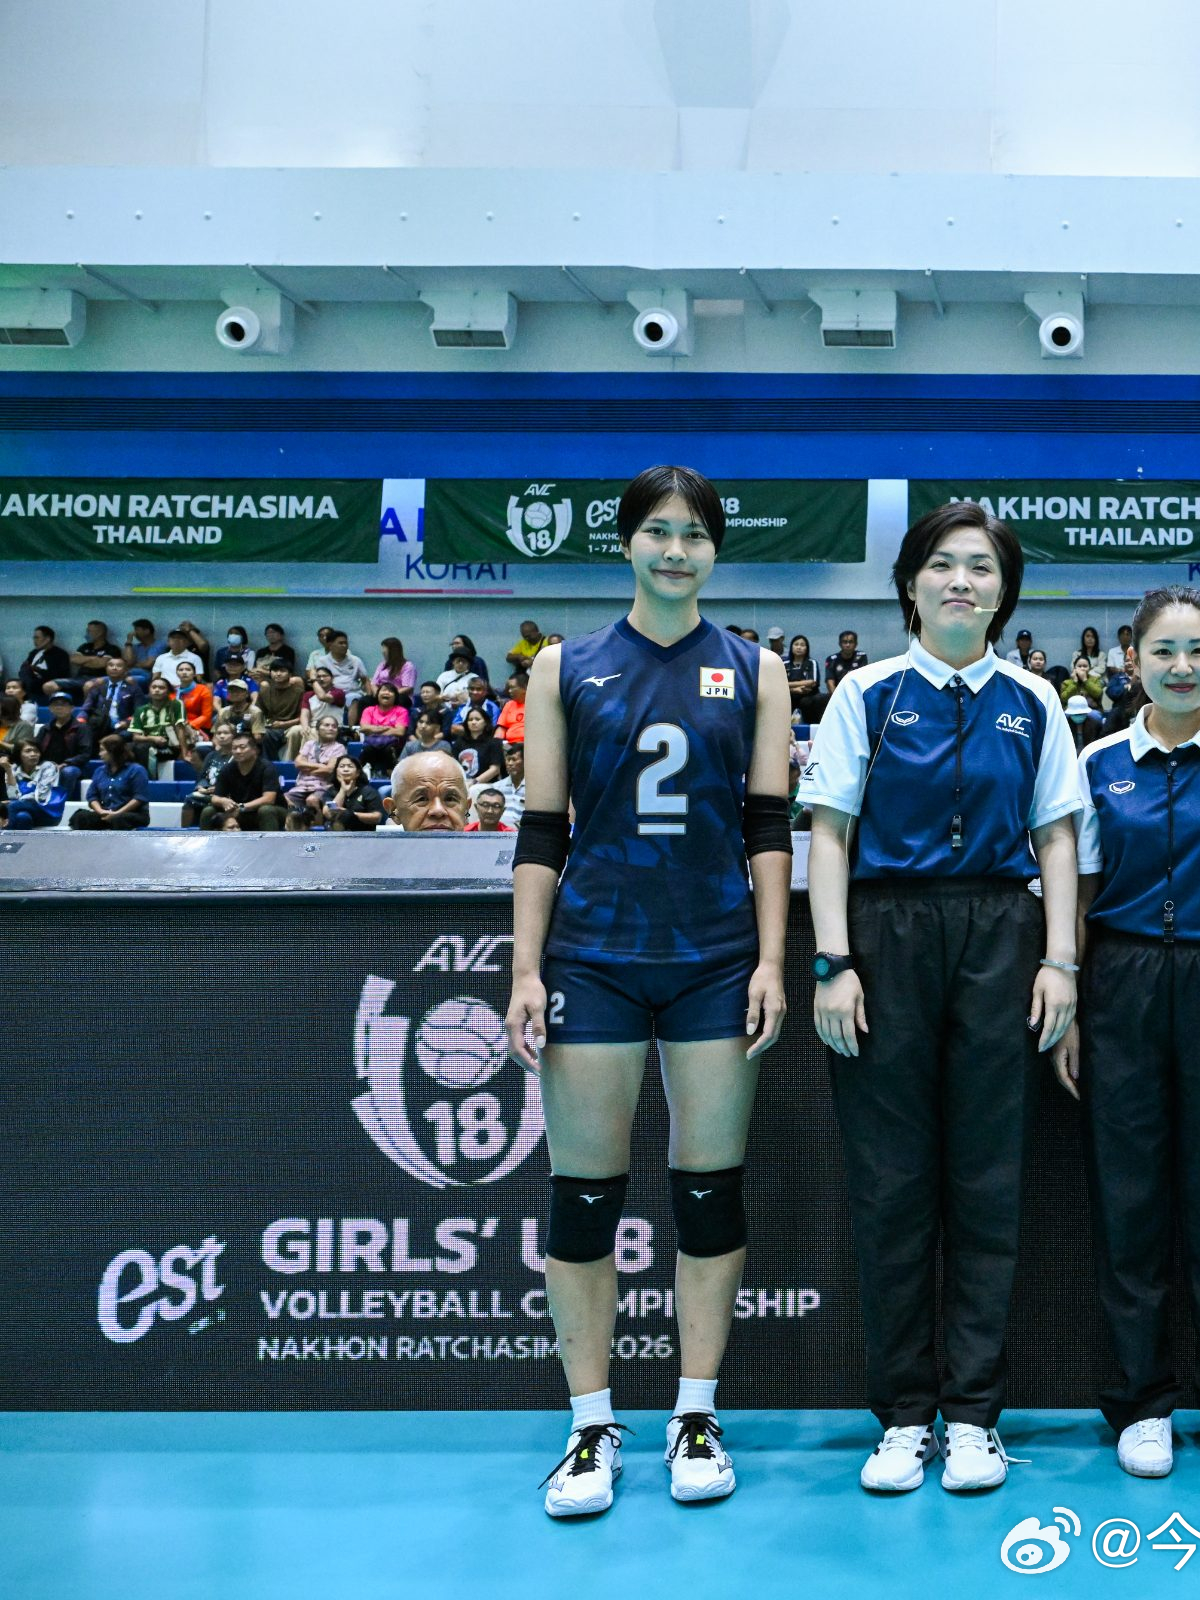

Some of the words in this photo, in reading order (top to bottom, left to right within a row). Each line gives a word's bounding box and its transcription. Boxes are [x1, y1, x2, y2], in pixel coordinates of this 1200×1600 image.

[524, 484, 556, 496] AVC
[0, 494, 119, 517] AKHON
[128, 494, 339, 519] RATCHASIMA
[950, 496, 1091, 520] AKHON
[93, 524, 223, 544] THAILAND
[725, 518, 788, 527] MPIONSHIP
[527, 529, 552, 551] 18
[589, 532, 620, 540] NAKHO
[1064, 527, 1194, 546] THAILAND
[706, 687, 729, 696] JPN
[996, 713, 1031, 730] AVC
[636, 723, 689, 816] 2
[413, 935, 515, 971] AVC
[550, 991, 565, 1024] 2
[423, 1092, 508, 1165] 18
[261, 1216, 499, 1275] GIRLS'
[98, 1234, 228, 1343] est
[259, 1289, 512, 1320] VOLLEYBALL
[257, 1335, 389, 1361] NAKHON
[397, 1335, 563, 1361] RATCHASIM
[611, 1334, 675, 1361] 026
